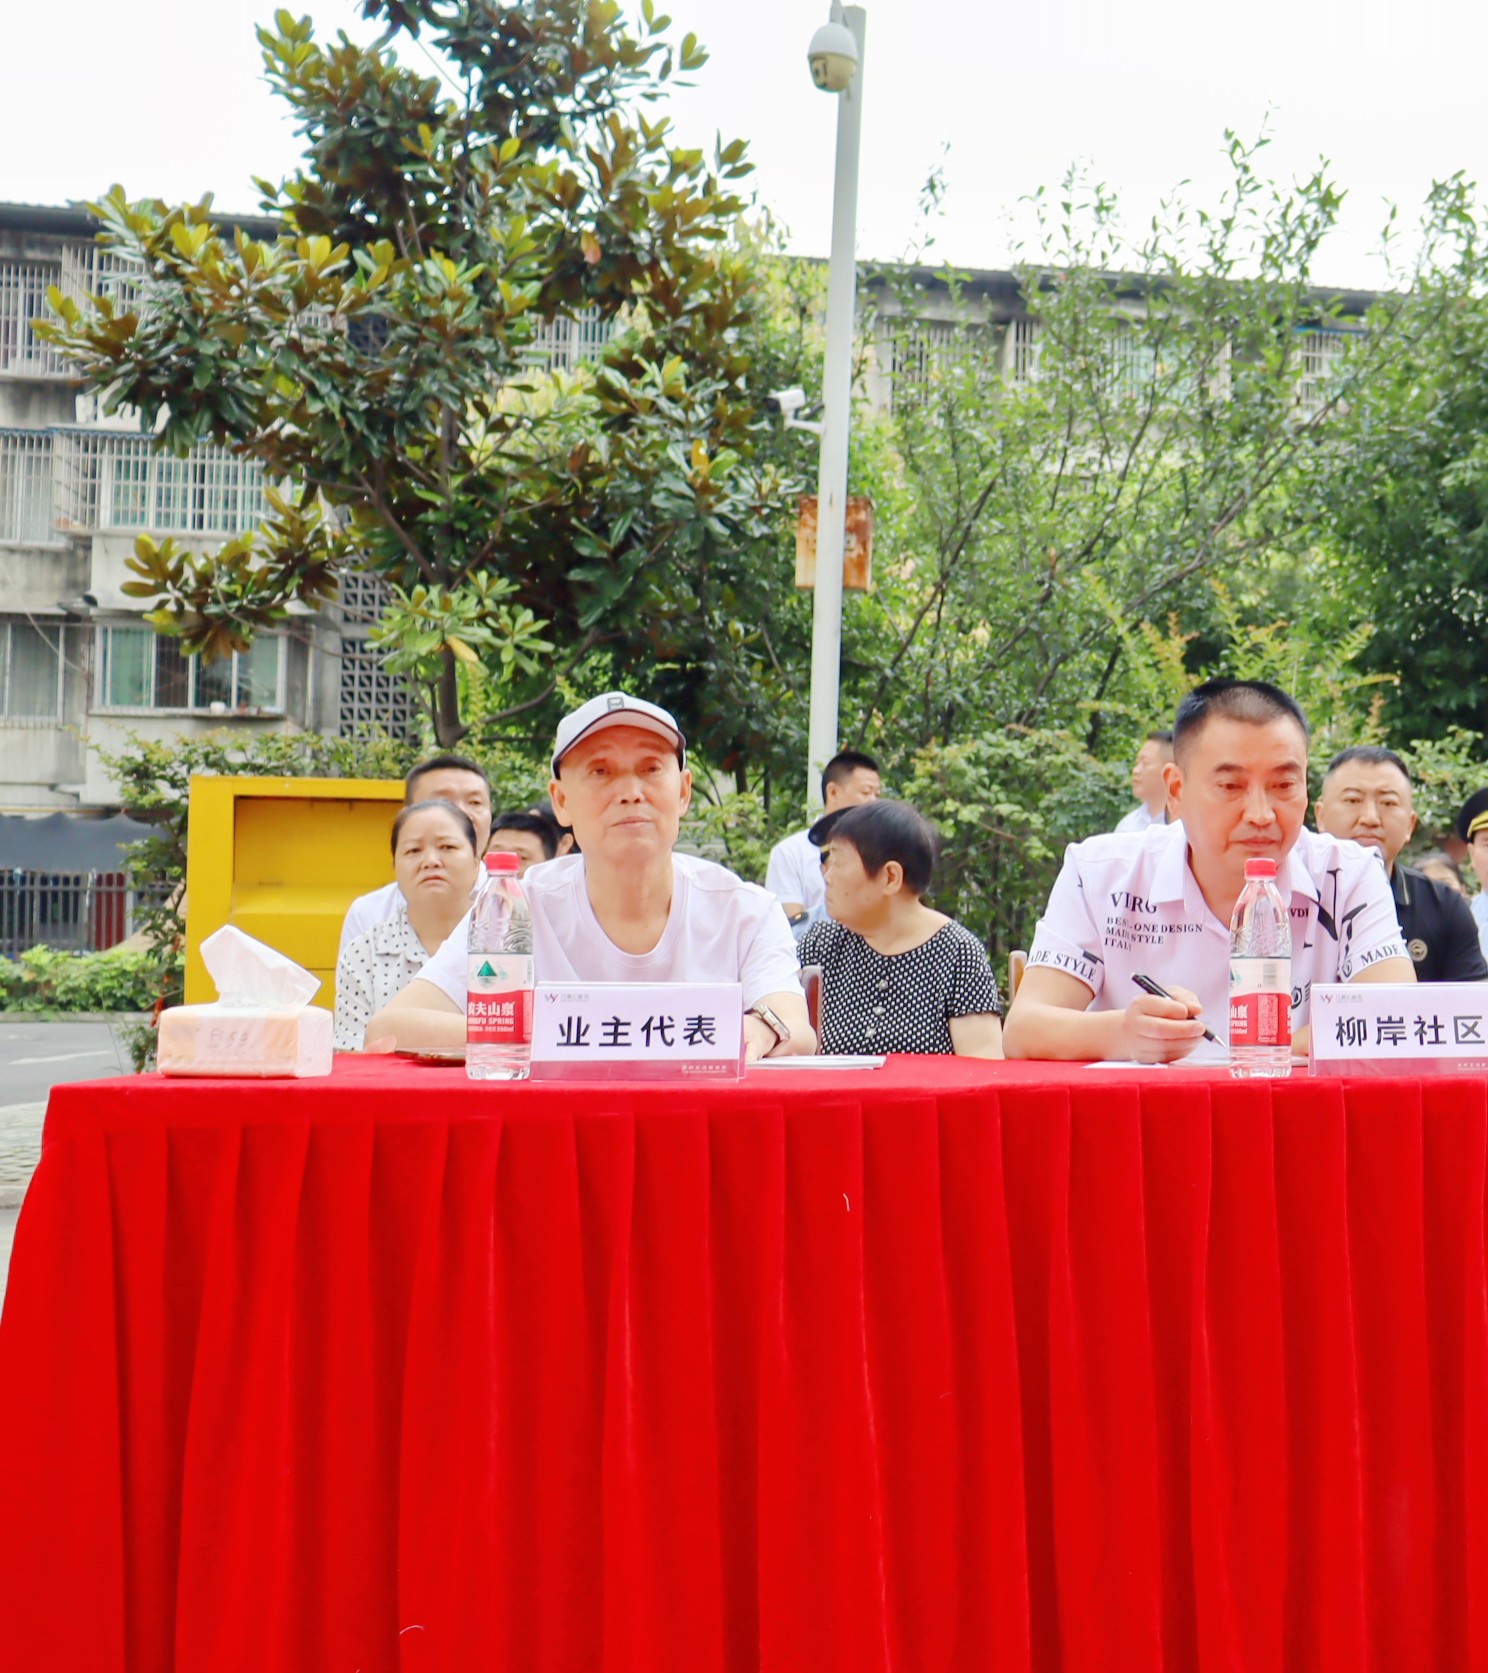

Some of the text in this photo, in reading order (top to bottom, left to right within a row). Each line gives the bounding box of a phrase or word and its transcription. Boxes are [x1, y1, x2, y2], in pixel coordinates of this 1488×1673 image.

[1161, 923, 1203, 933] DESIGN
[1131, 934, 1164, 945] STYLE
[1054, 953, 1097, 982] STYLE
[488, 1017, 514, 1025] SPRING
[556, 1015, 716, 1047] 业主代表
[1335, 1014, 1486, 1047] 柳岸社区
